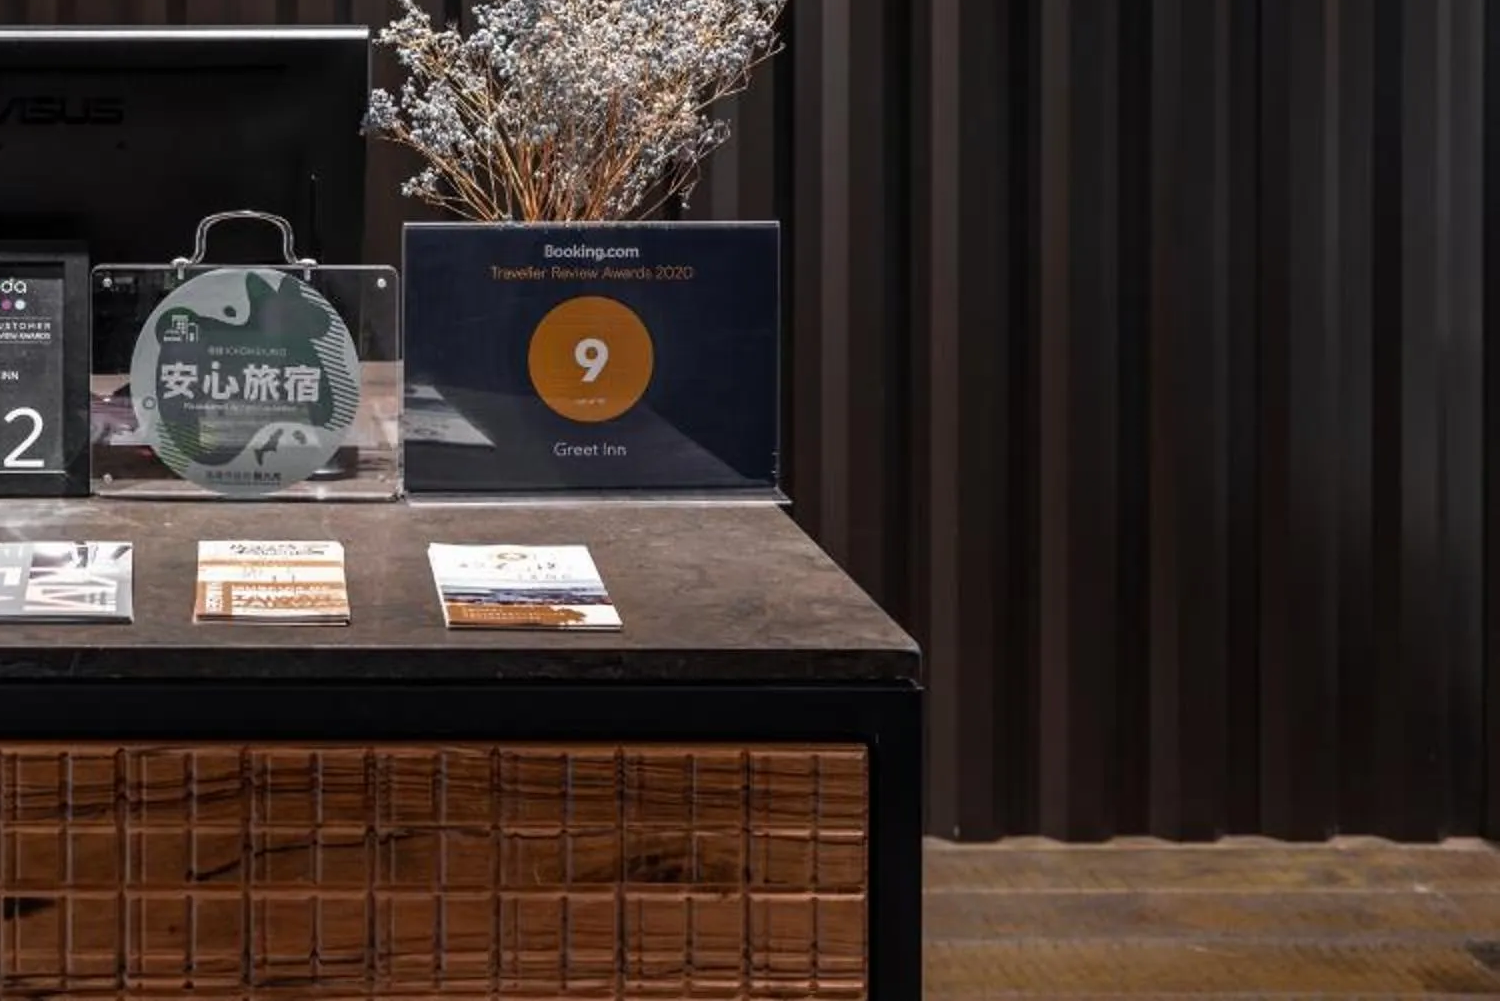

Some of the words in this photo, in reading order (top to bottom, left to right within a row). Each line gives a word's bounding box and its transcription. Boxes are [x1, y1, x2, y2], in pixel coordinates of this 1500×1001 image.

[544, 244, 640, 261] Booking.com
[551, 267, 599, 281] Review
[601, 266, 653, 281] Awards
[655, 266, 694, 281] 2020
[575, 338, 609, 382] 9
[1, 370, 19, 380] INN
[161, 361, 321, 402] 安心旅宿
[553, 442, 599, 457] Greet
[603, 442, 628, 457] Inn
